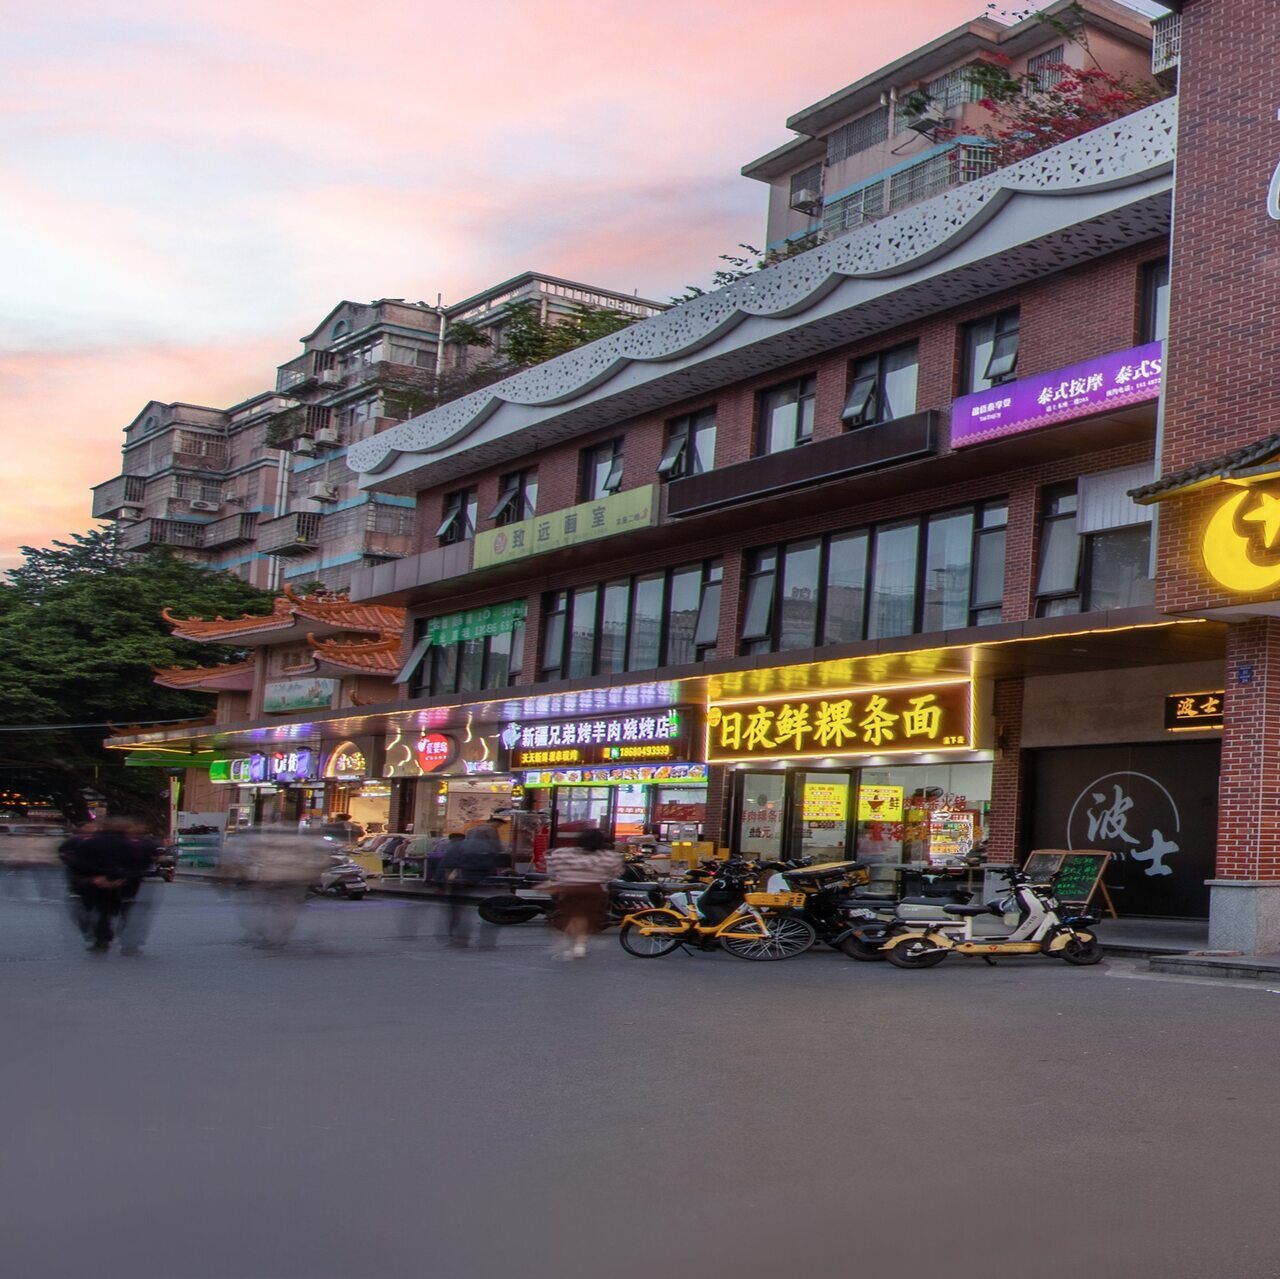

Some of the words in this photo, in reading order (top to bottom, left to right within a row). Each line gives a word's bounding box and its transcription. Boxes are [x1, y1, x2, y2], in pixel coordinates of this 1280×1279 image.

[1036, 372, 1104, 406] 泰式按摩
[521, 716, 671, 748] 新疆兄弟烤羊肉烧烤店
[720, 694, 942, 751] 日夜鲜粿条面
[1086, 783, 1181, 877] 波士
